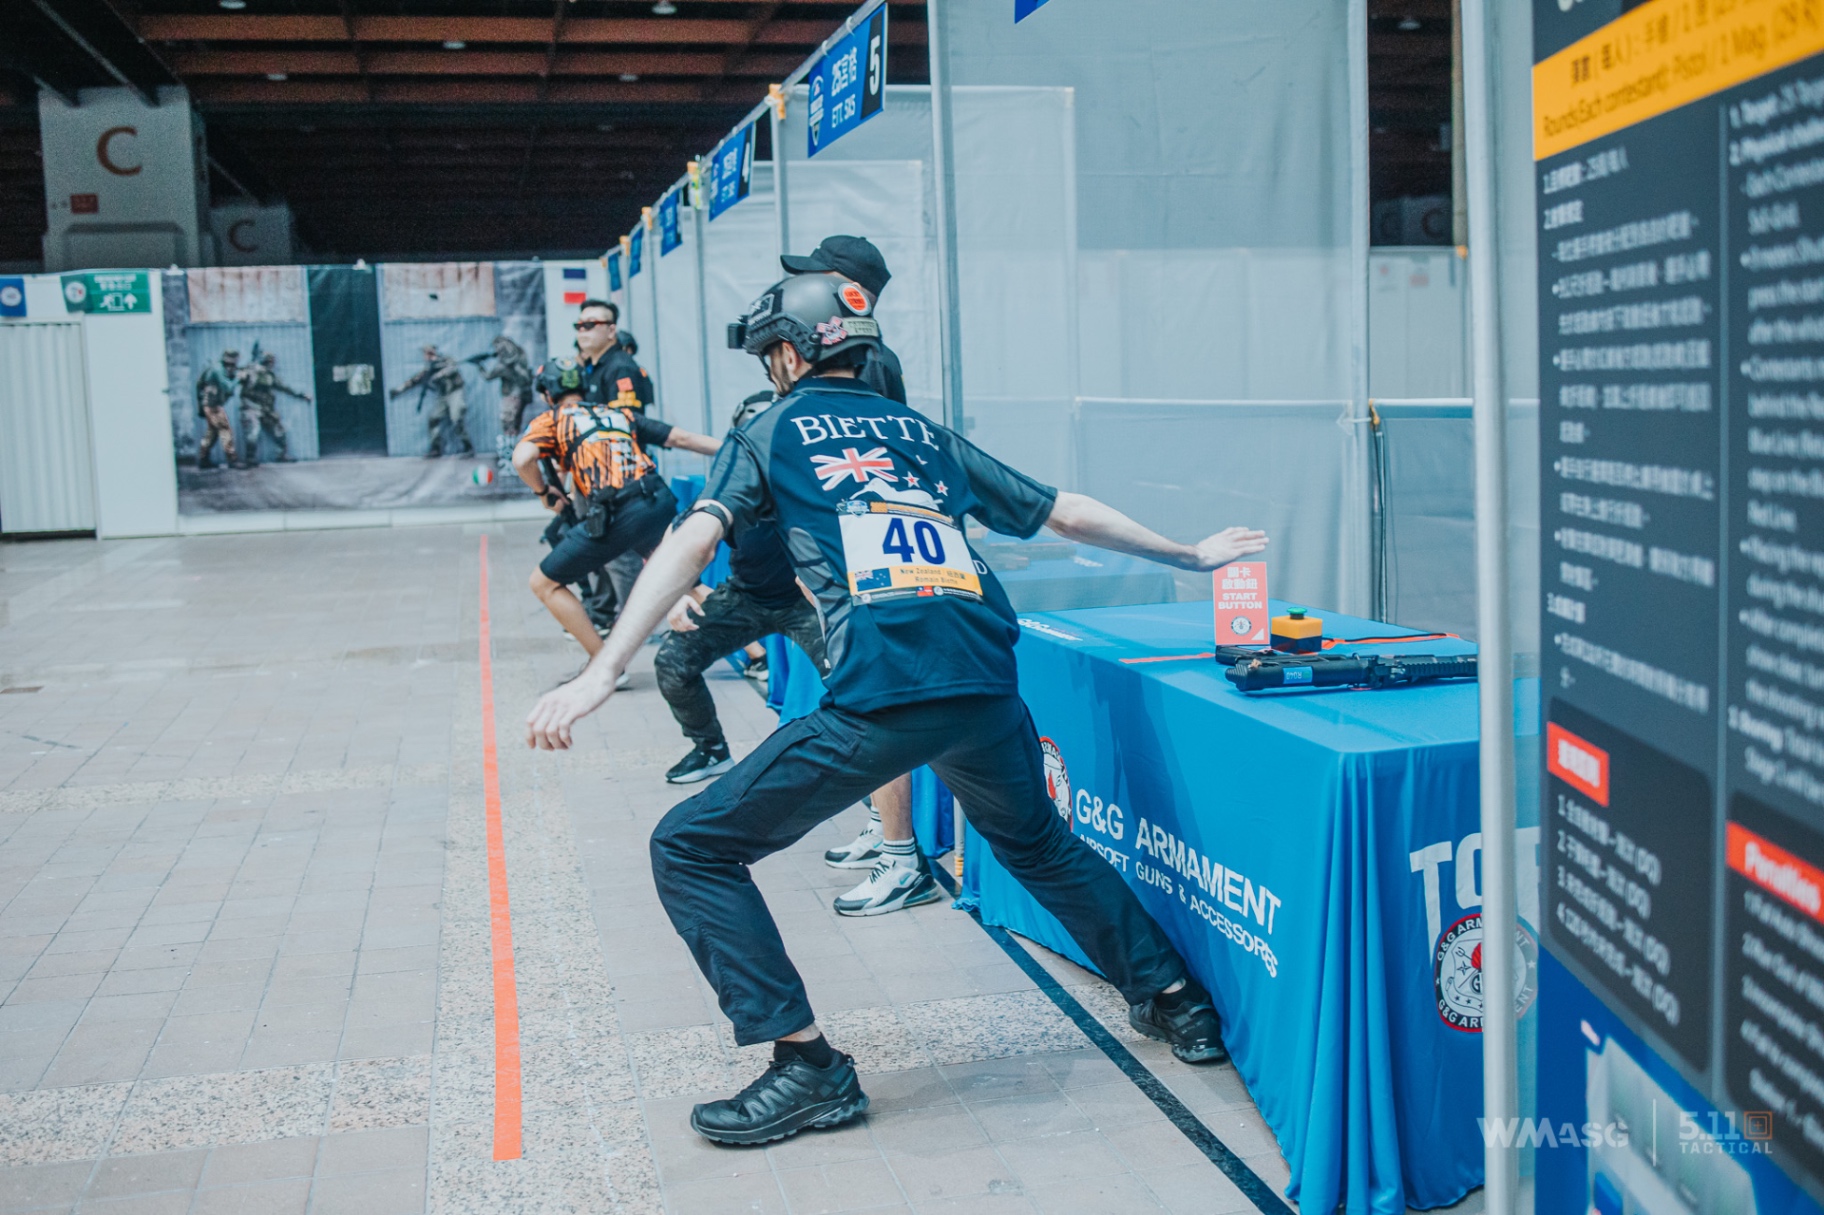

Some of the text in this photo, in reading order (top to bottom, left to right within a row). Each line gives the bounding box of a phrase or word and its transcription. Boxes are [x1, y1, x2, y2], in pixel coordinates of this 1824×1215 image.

[868, 35, 881, 96] 5
[97, 126, 142, 176] C
[229, 219, 258, 252] C
[790, 414, 940, 452] BIETTE
[882, 517, 946, 565] 40
[915, 567, 942, 576] Zealand
[973, 560, 988, 575] D
[1218, 601, 1263, 610] BUTTON
[1222, 592, 1258, 601] START
[1076, 788, 1282, 935] G&G ARMAMENT
[1744, 841, 1821, 914] Penalties
[1136, 861, 1173, 895] GUNS
[1179, 883, 1187, 906] &
